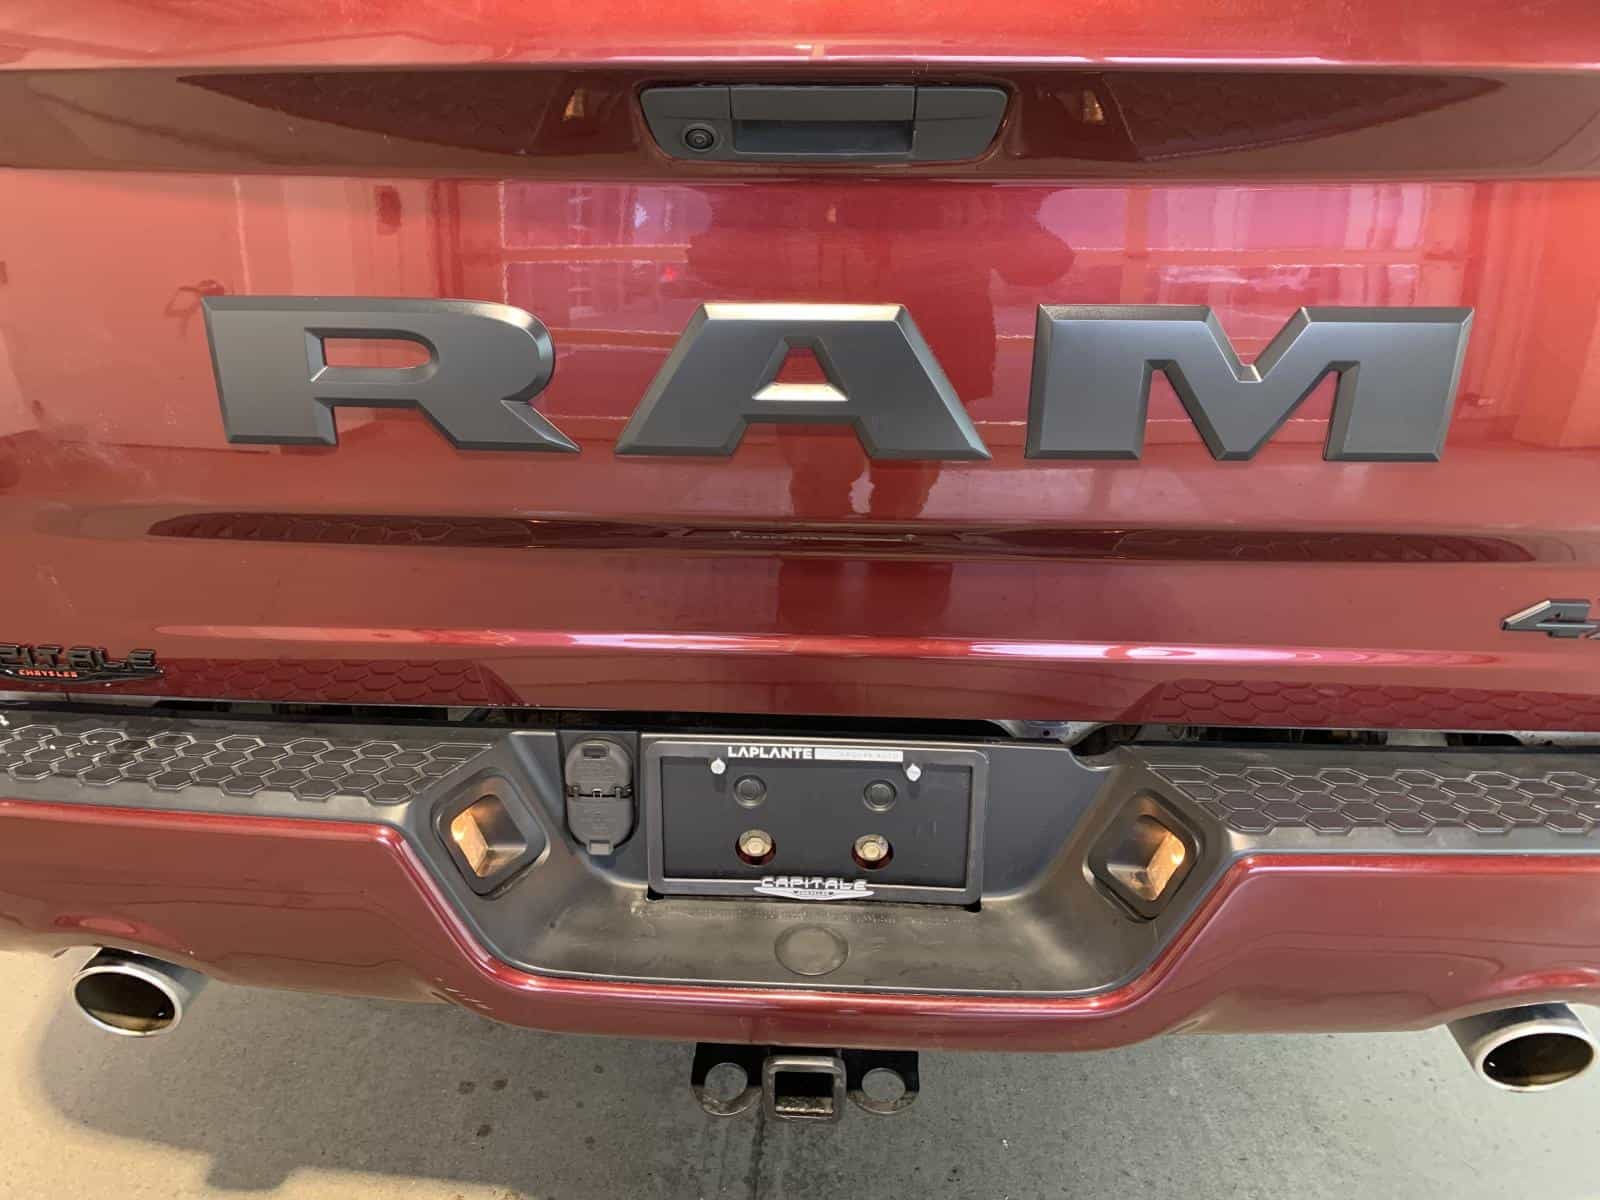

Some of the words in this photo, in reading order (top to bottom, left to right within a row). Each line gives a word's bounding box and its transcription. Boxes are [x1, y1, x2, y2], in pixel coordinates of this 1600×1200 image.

[201, 296, 1475, 462] RAM
[1502, 599, 1600, 639] 4
[727, 746, 813, 759] LAPLANTE
[761, 876, 867, 890] CAPITALE
